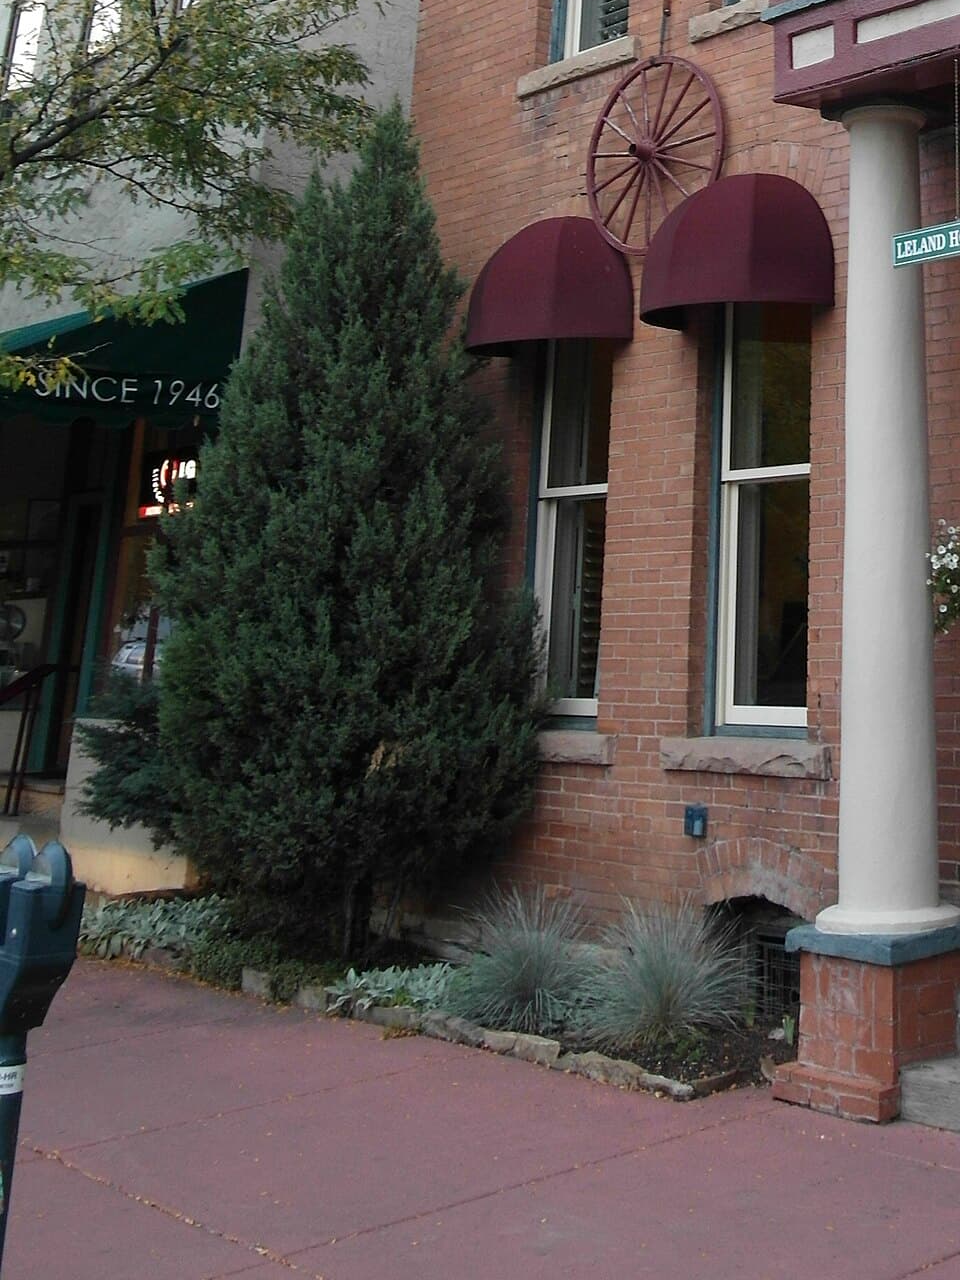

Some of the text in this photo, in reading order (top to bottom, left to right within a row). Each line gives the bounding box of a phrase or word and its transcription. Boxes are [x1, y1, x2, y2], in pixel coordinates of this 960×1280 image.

[896, 235, 946, 259] LELAND
[35, 365, 220, 409] SINCE 1946
